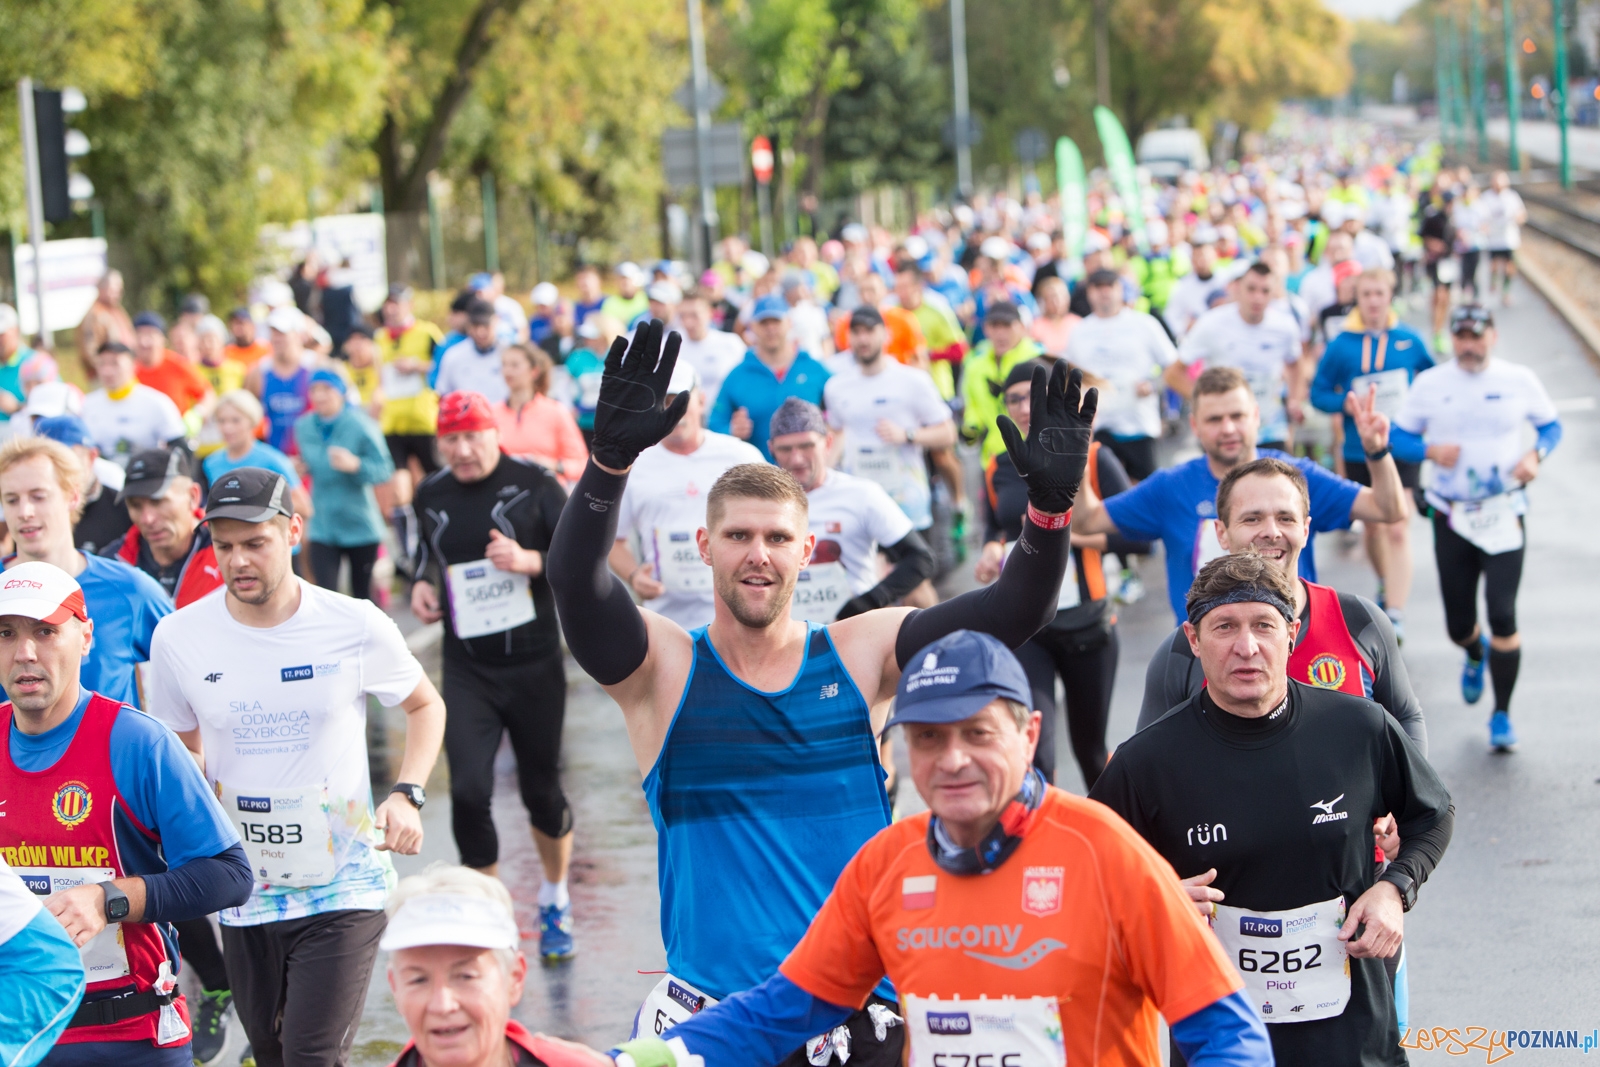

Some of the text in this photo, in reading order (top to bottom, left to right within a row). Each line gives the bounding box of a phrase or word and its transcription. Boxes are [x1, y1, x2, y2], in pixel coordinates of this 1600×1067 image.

[466, 579, 514, 605] 5609
[204, 672, 223, 683] 4F
[229, 700, 263, 713] SIŁA
[241, 710, 310, 725] ODWAGA
[232, 722, 310, 739] SZYBKOŚĆ
[235, 747, 241, 755] 9
[242, 746, 289, 756] października
[240, 800, 268, 809] 17.PKO
[241, 822, 303, 844] 1583
[50, 846, 110, 867] WLKP.
[261, 849, 286, 859] Piotr
[1244, 922, 1279, 933] 17.PKO
[1286, 921, 1317, 934] maraton
[897, 924, 1023, 953] saucony
[1239, 944, 1322, 973] 6262
[1267, 981, 1297, 990] Piotr
